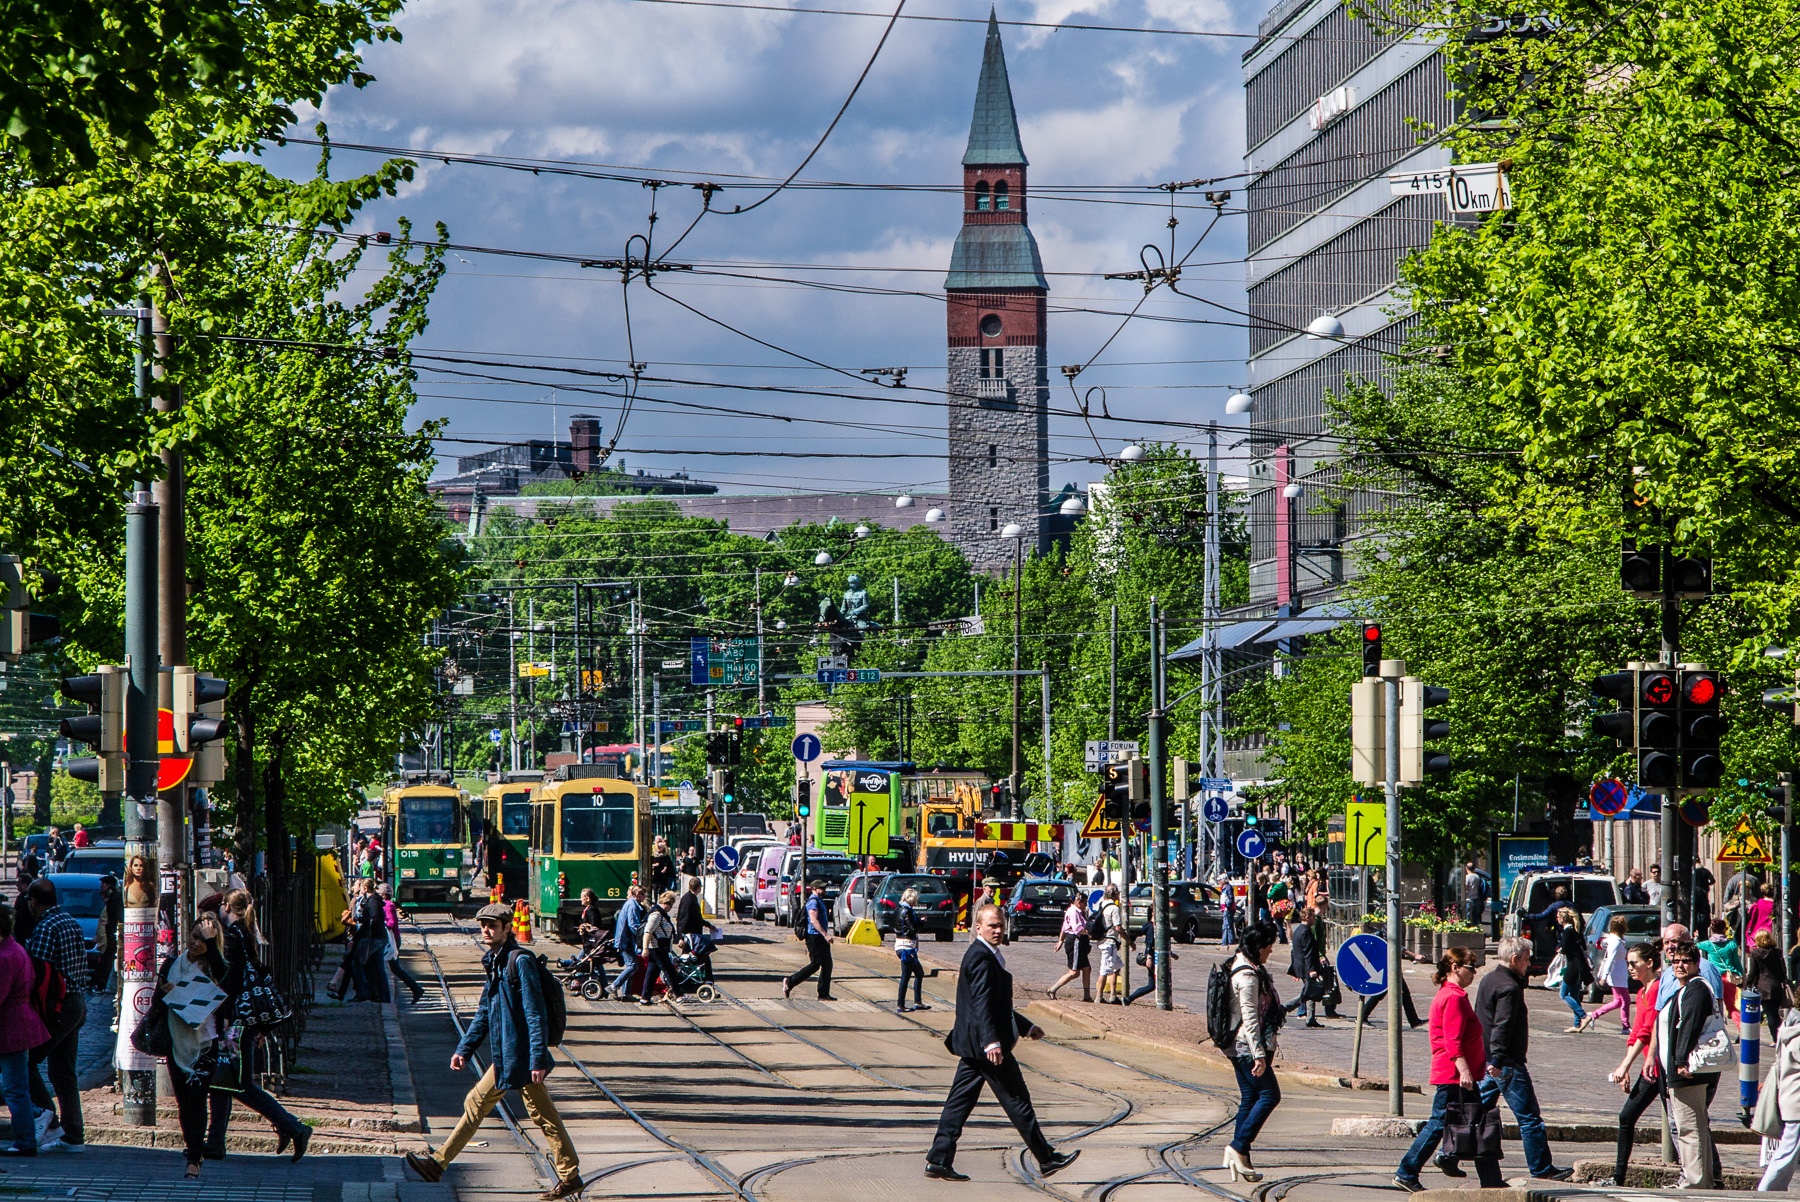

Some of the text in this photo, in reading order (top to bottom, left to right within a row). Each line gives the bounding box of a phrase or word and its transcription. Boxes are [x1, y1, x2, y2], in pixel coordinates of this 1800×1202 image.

[1411, 173, 1443, 191] 415
[849, 672, 855, 680] 3
[867, 671, 876, 680] 12
[676, 721, 682, 730] 3
[690, 721, 698, 730] 12
[592, 795, 604, 806] 10
[607, 888, 620, 897] 63
